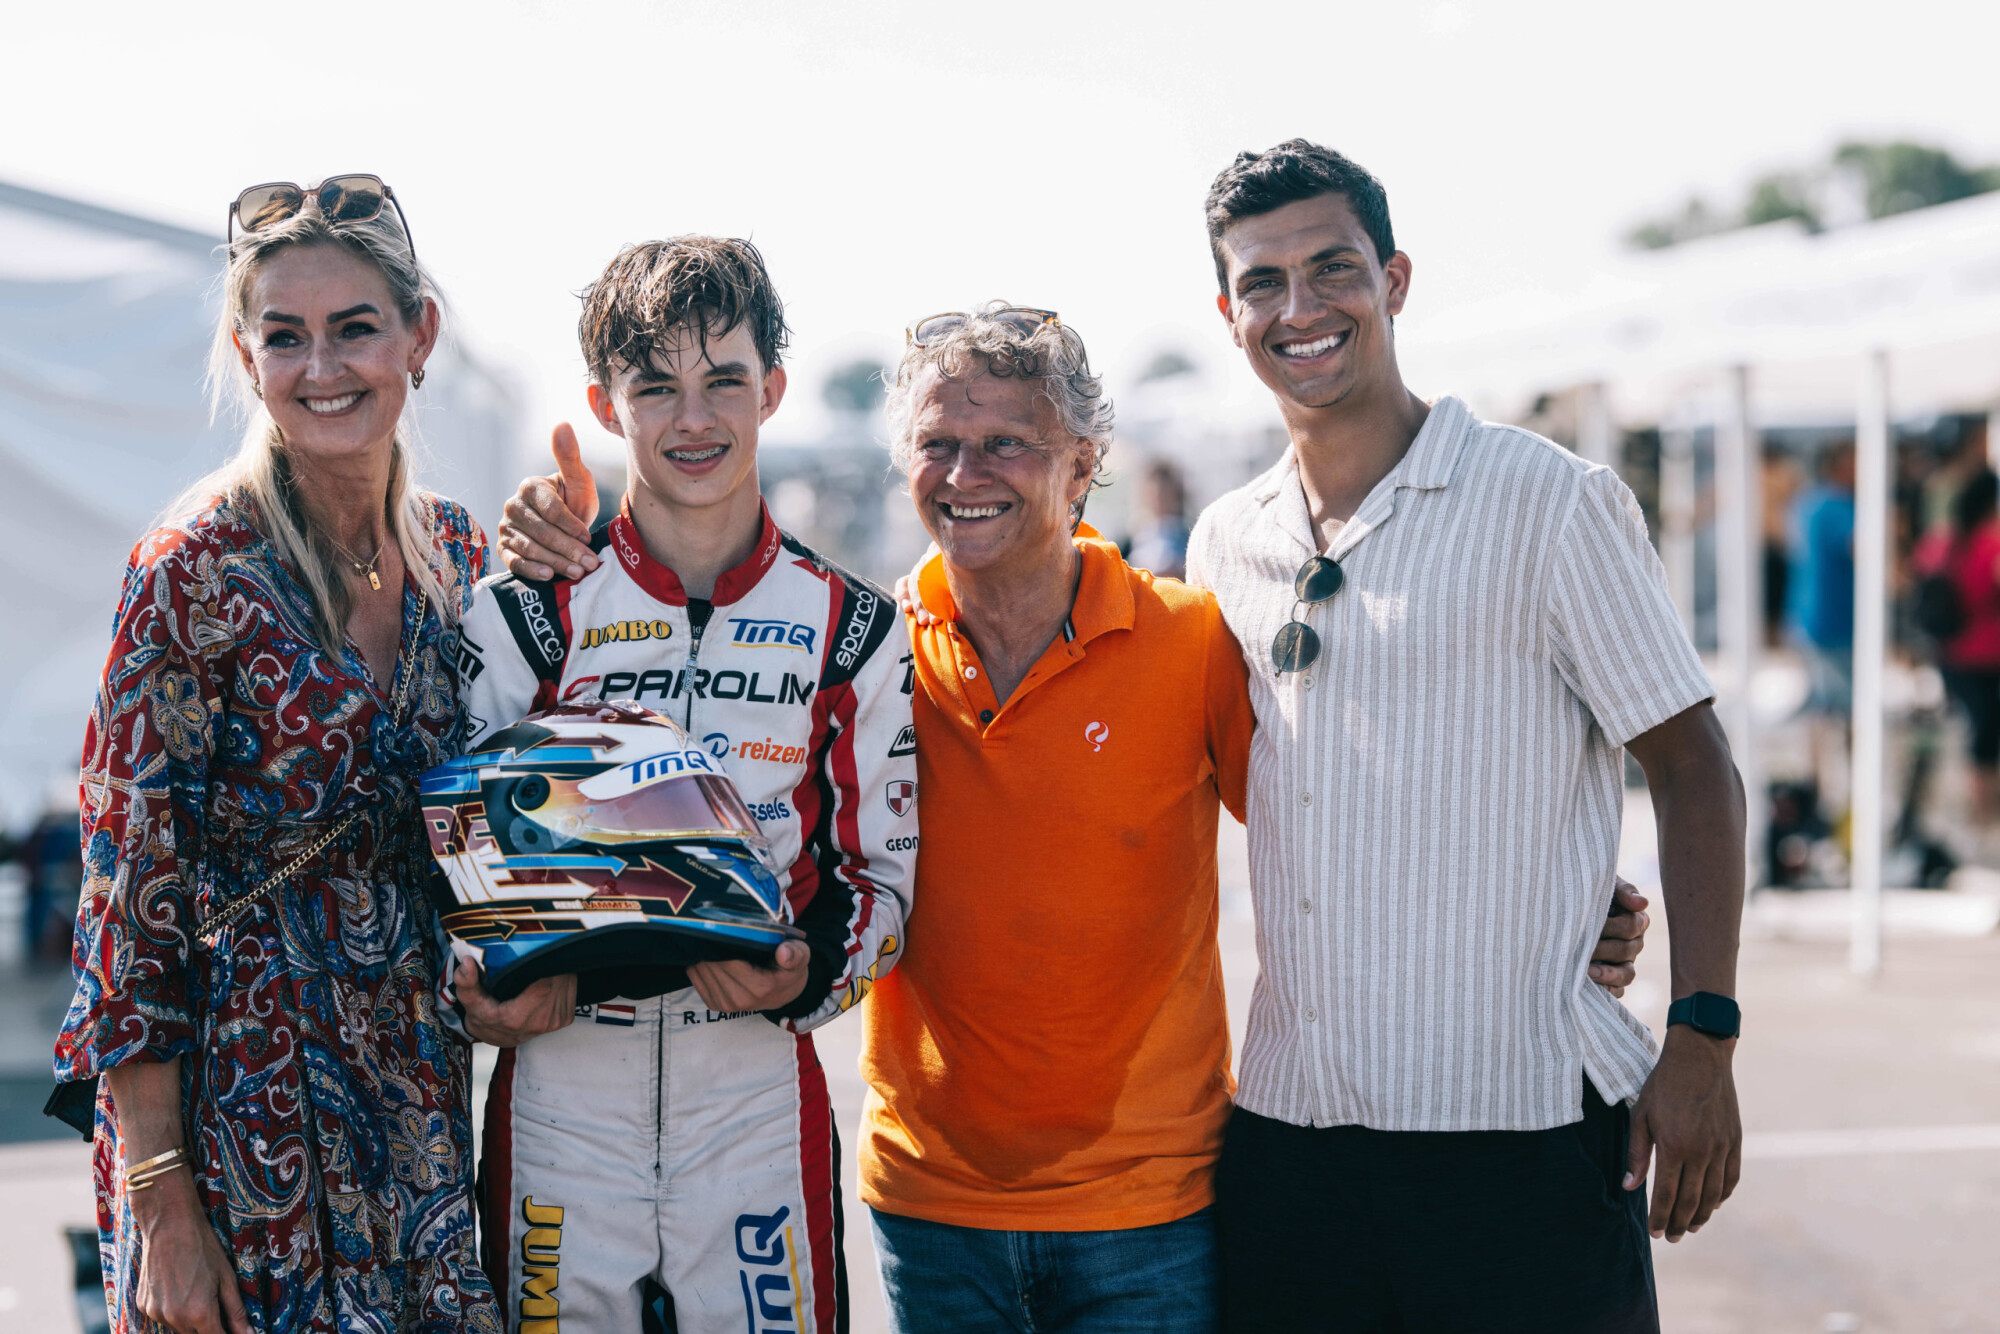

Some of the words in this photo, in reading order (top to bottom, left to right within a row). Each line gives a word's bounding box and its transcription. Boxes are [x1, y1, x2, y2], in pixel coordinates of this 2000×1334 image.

[517, 589, 565, 667] sparco
[580, 619, 673, 650] JUMBO
[836, 590, 878, 671] sparco
[600, 669, 816, 706] PAROLIN
[683, 1010, 701, 1025] R.
